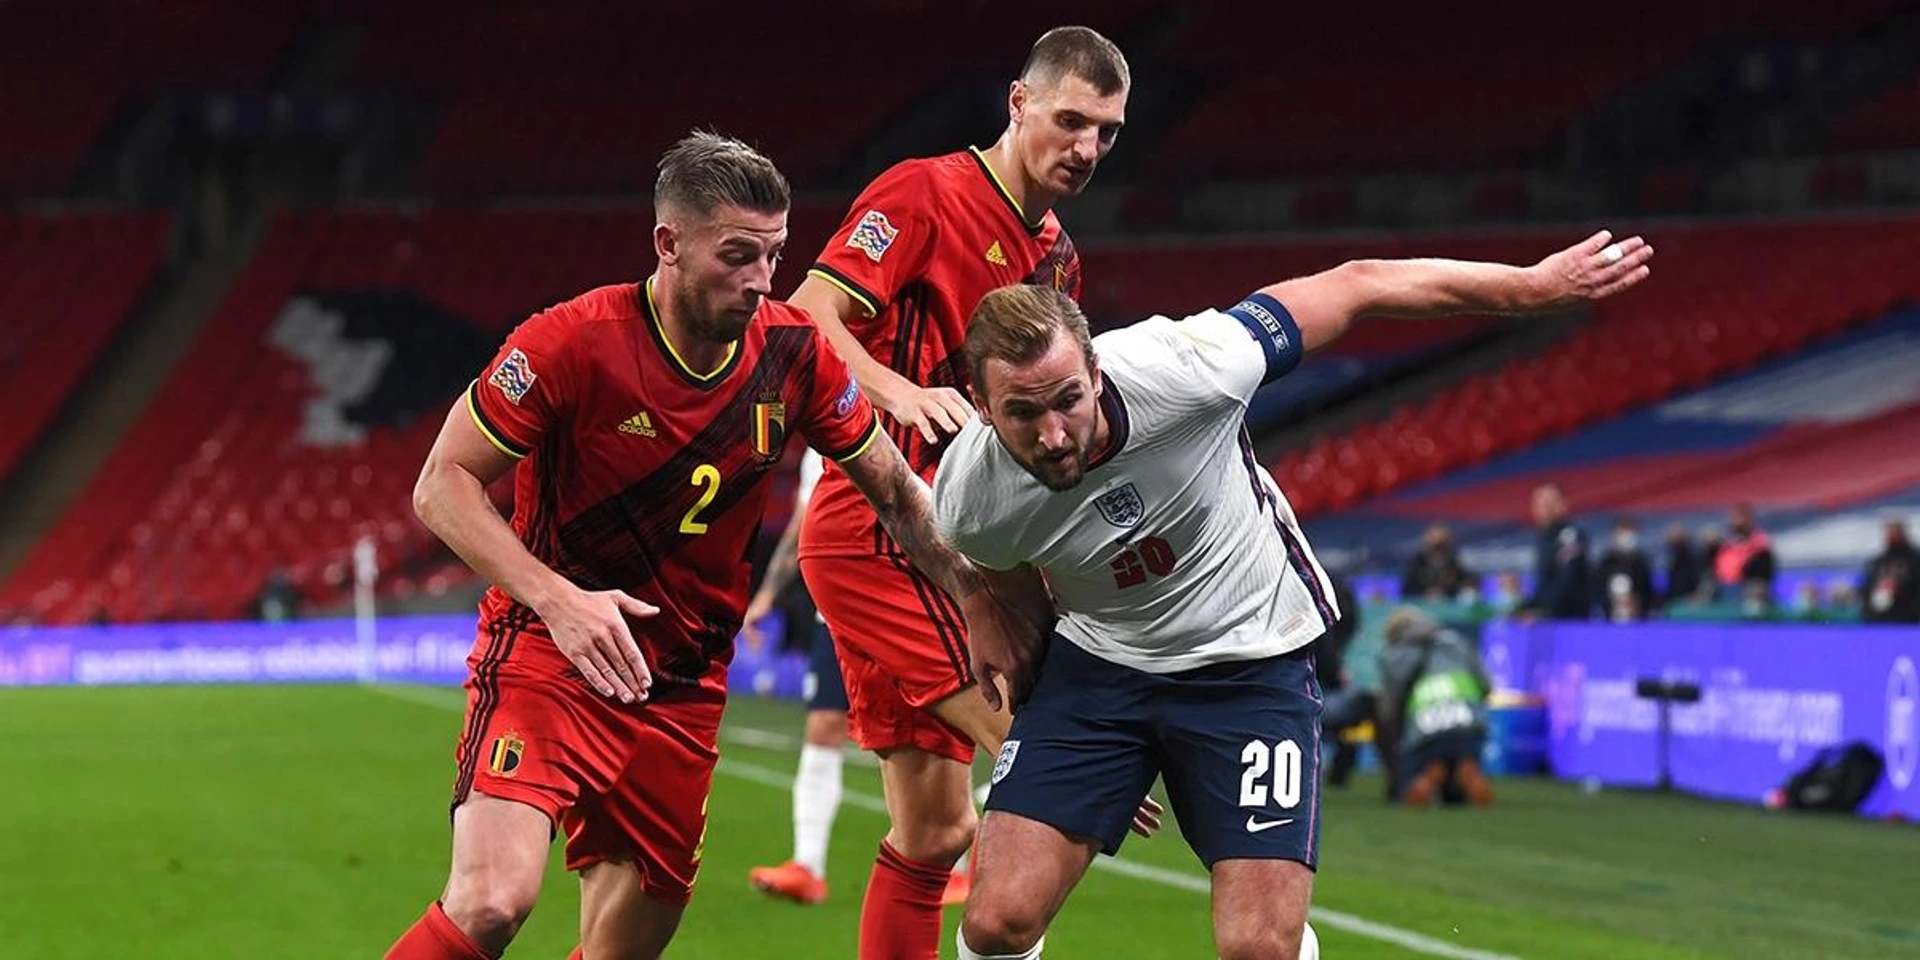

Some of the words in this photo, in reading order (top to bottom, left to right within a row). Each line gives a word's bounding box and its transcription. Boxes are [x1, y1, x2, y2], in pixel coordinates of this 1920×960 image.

[617, 423, 657, 438] adidas
[679, 464, 720, 534] 2
[1110, 536, 1178, 589] 20
[1239, 739, 1302, 809] 20
